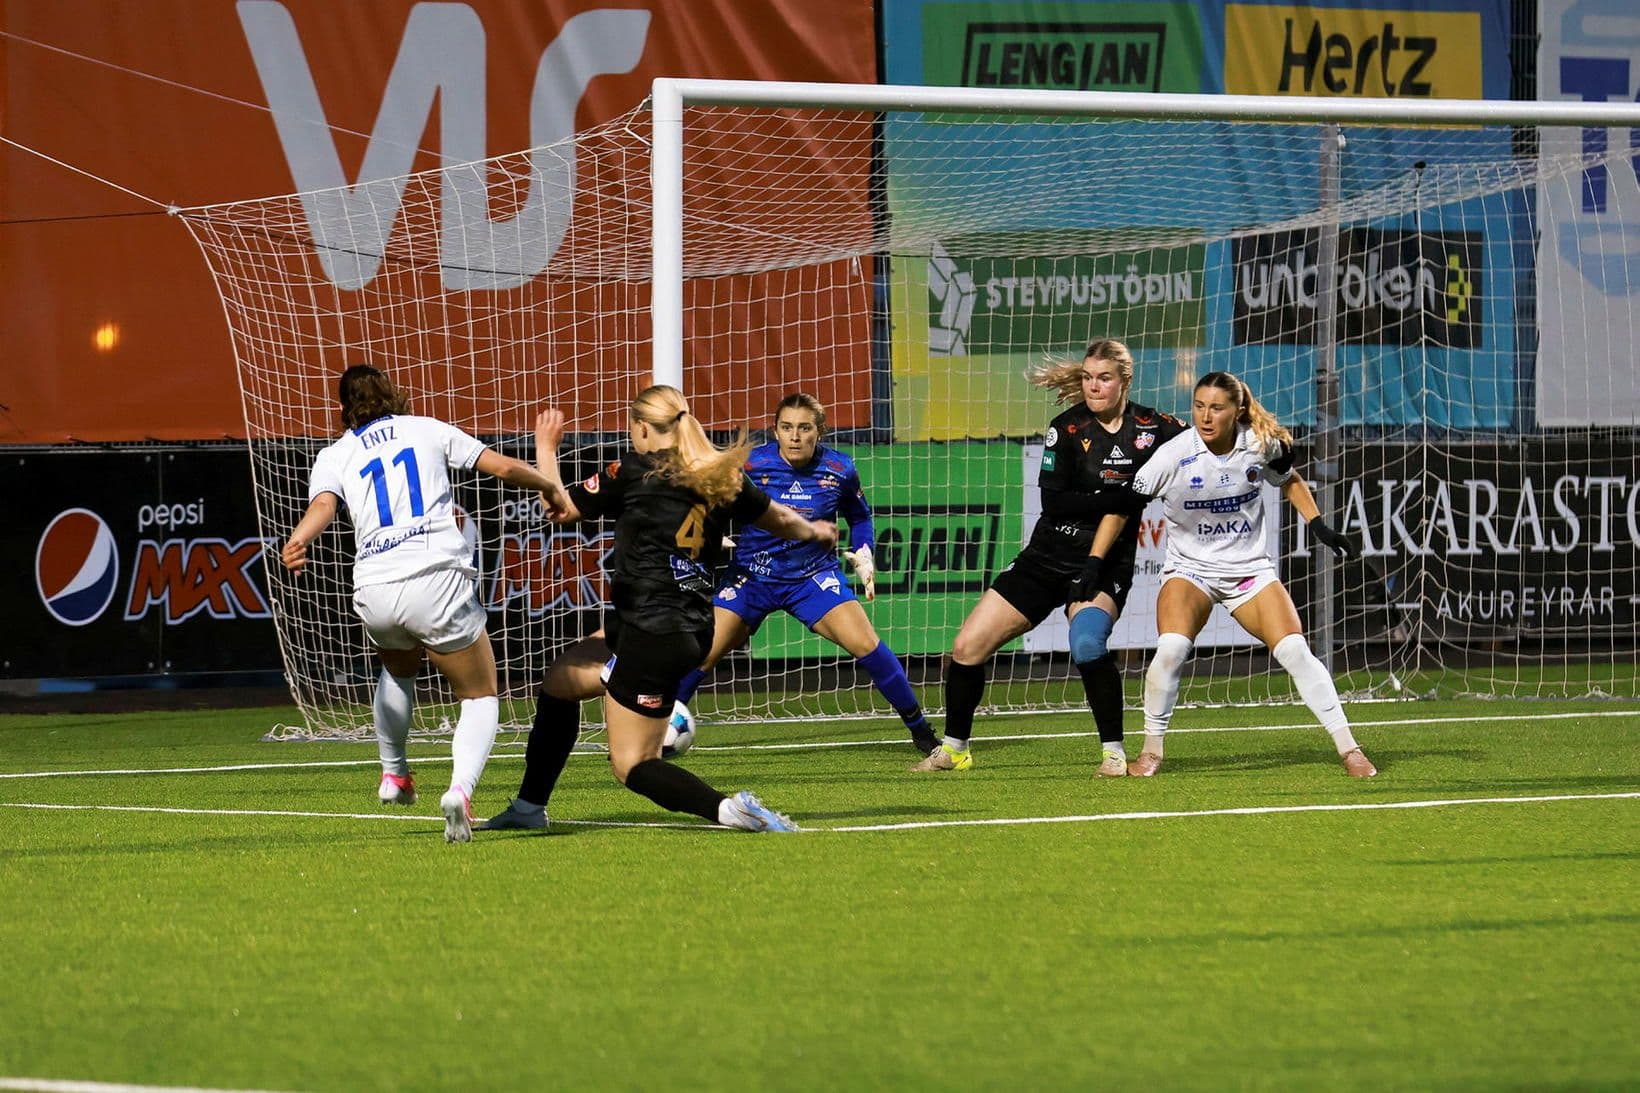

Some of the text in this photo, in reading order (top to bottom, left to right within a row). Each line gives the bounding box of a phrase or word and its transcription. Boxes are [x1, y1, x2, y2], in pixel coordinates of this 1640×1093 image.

[1278, 18, 1438, 97] Hertz
[361, 426, 397, 449] ENTZ
[359, 446, 425, 528] 11
[138, 498, 204, 533] pepsi
[503, 499, 546, 527] pep
[1213, 505, 1239, 513] 1909
[1292, 475, 1640, 557] AKARAST
[675, 503, 707, 559] 4
[123, 537, 280, 625] MAX
[749, 562, 772, 577] LYST
[1436, 586, 1615, 619] AKUREYRAR
